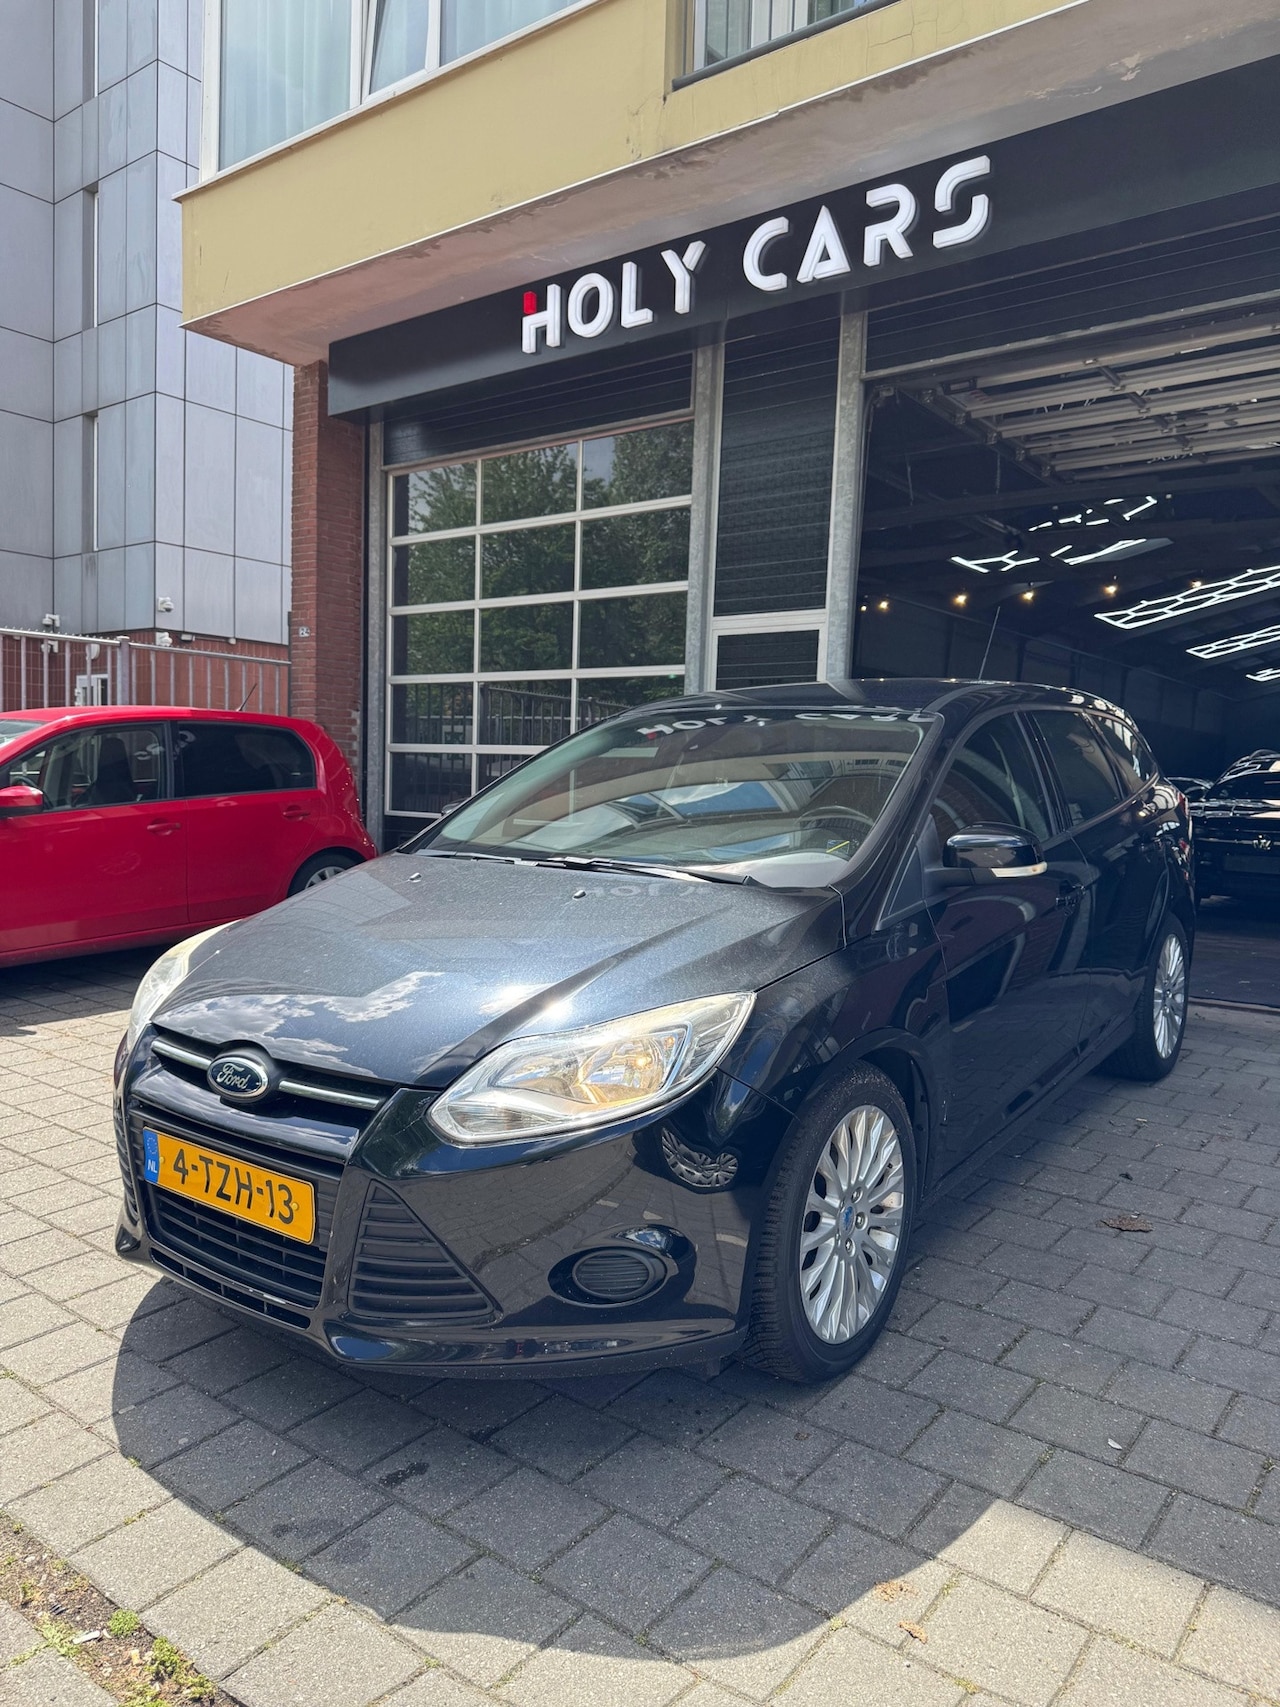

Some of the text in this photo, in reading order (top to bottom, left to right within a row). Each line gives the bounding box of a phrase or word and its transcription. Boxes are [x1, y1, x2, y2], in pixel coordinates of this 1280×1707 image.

[522, 155, 991, 354] HOLY CARS
[216, 1062, 251, 1091] Ford
[147, 1159, 158, 1174] NL
[173, 1148, 295, 1225] 4-TZH-13
